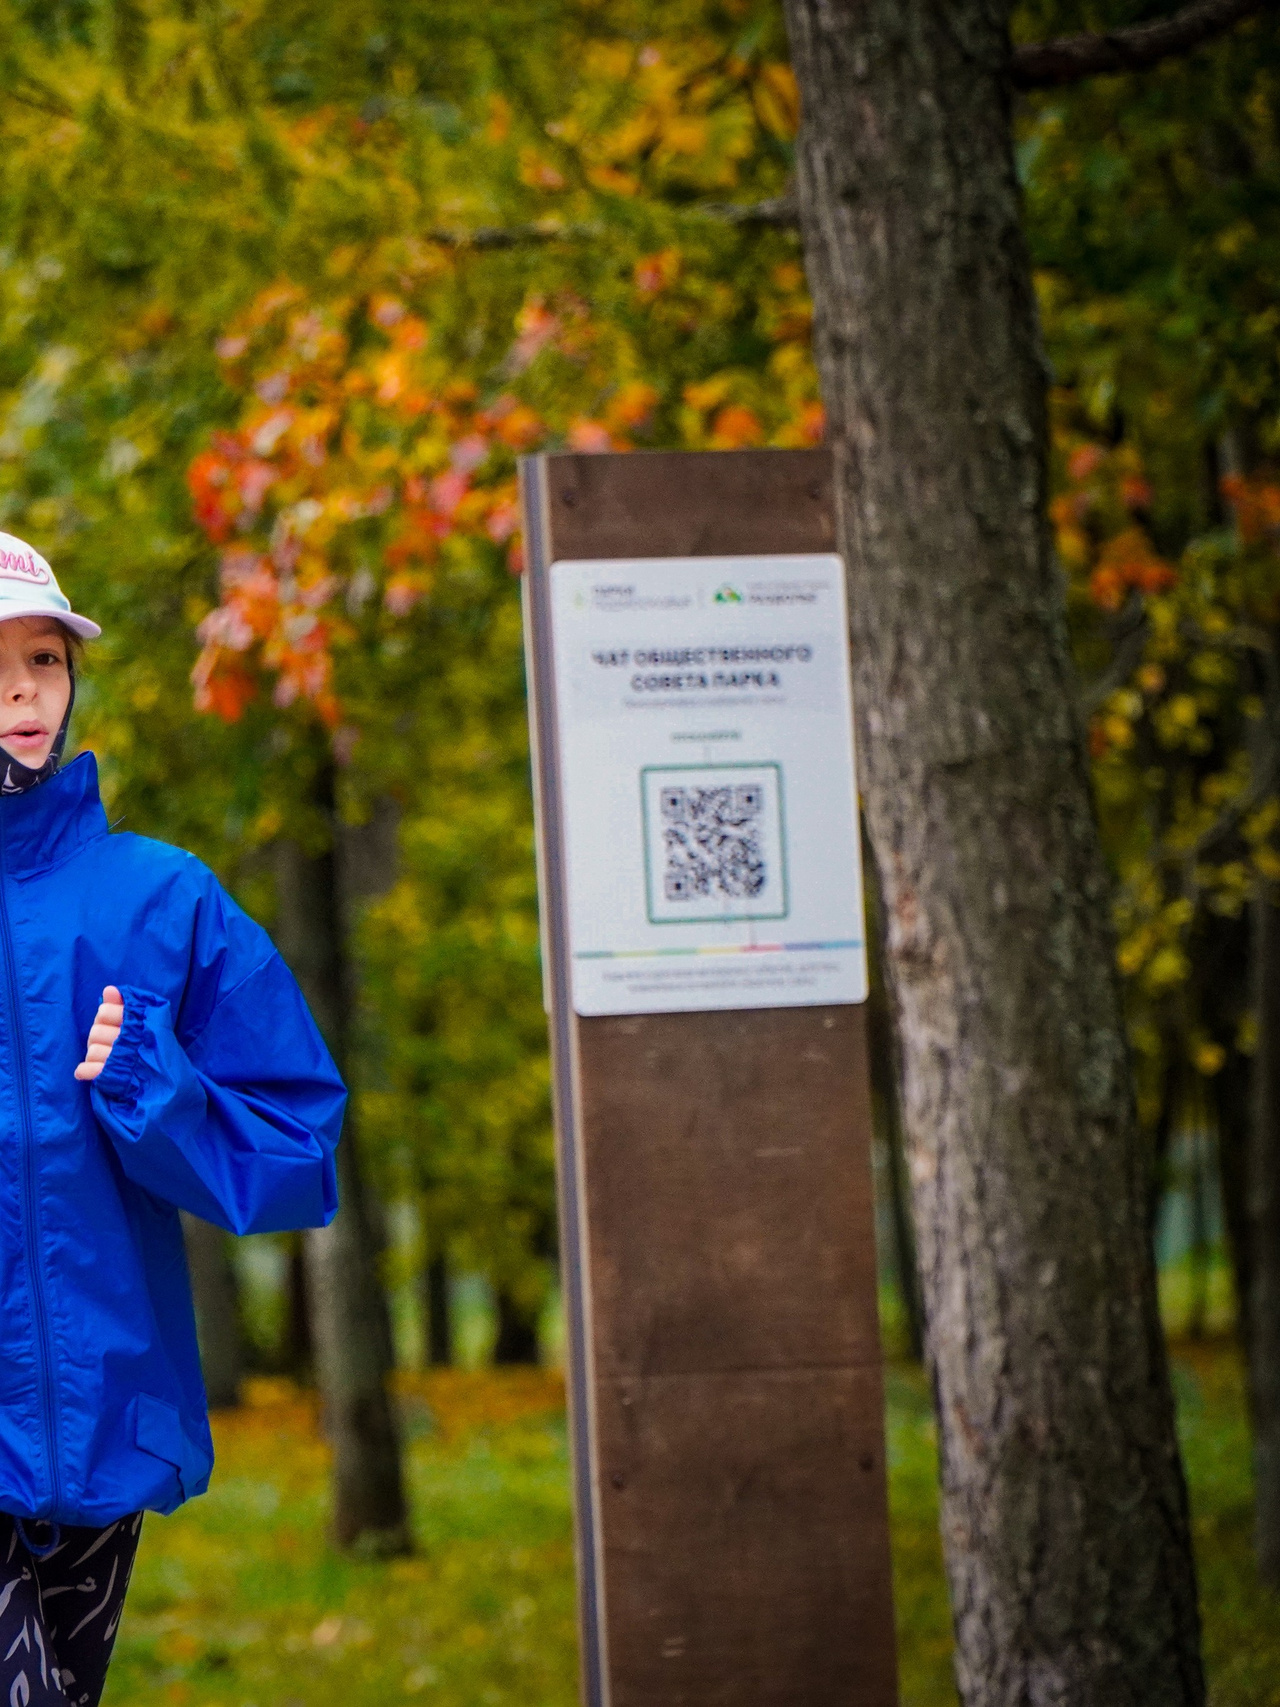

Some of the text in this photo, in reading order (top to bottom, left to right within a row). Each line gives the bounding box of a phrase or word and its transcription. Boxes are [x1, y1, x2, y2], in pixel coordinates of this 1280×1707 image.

[634, 644, 813, 667] ОБЩЕСТВЕННОГО
[631, 670, 780, 691] СОВЕТА ПАРКА
